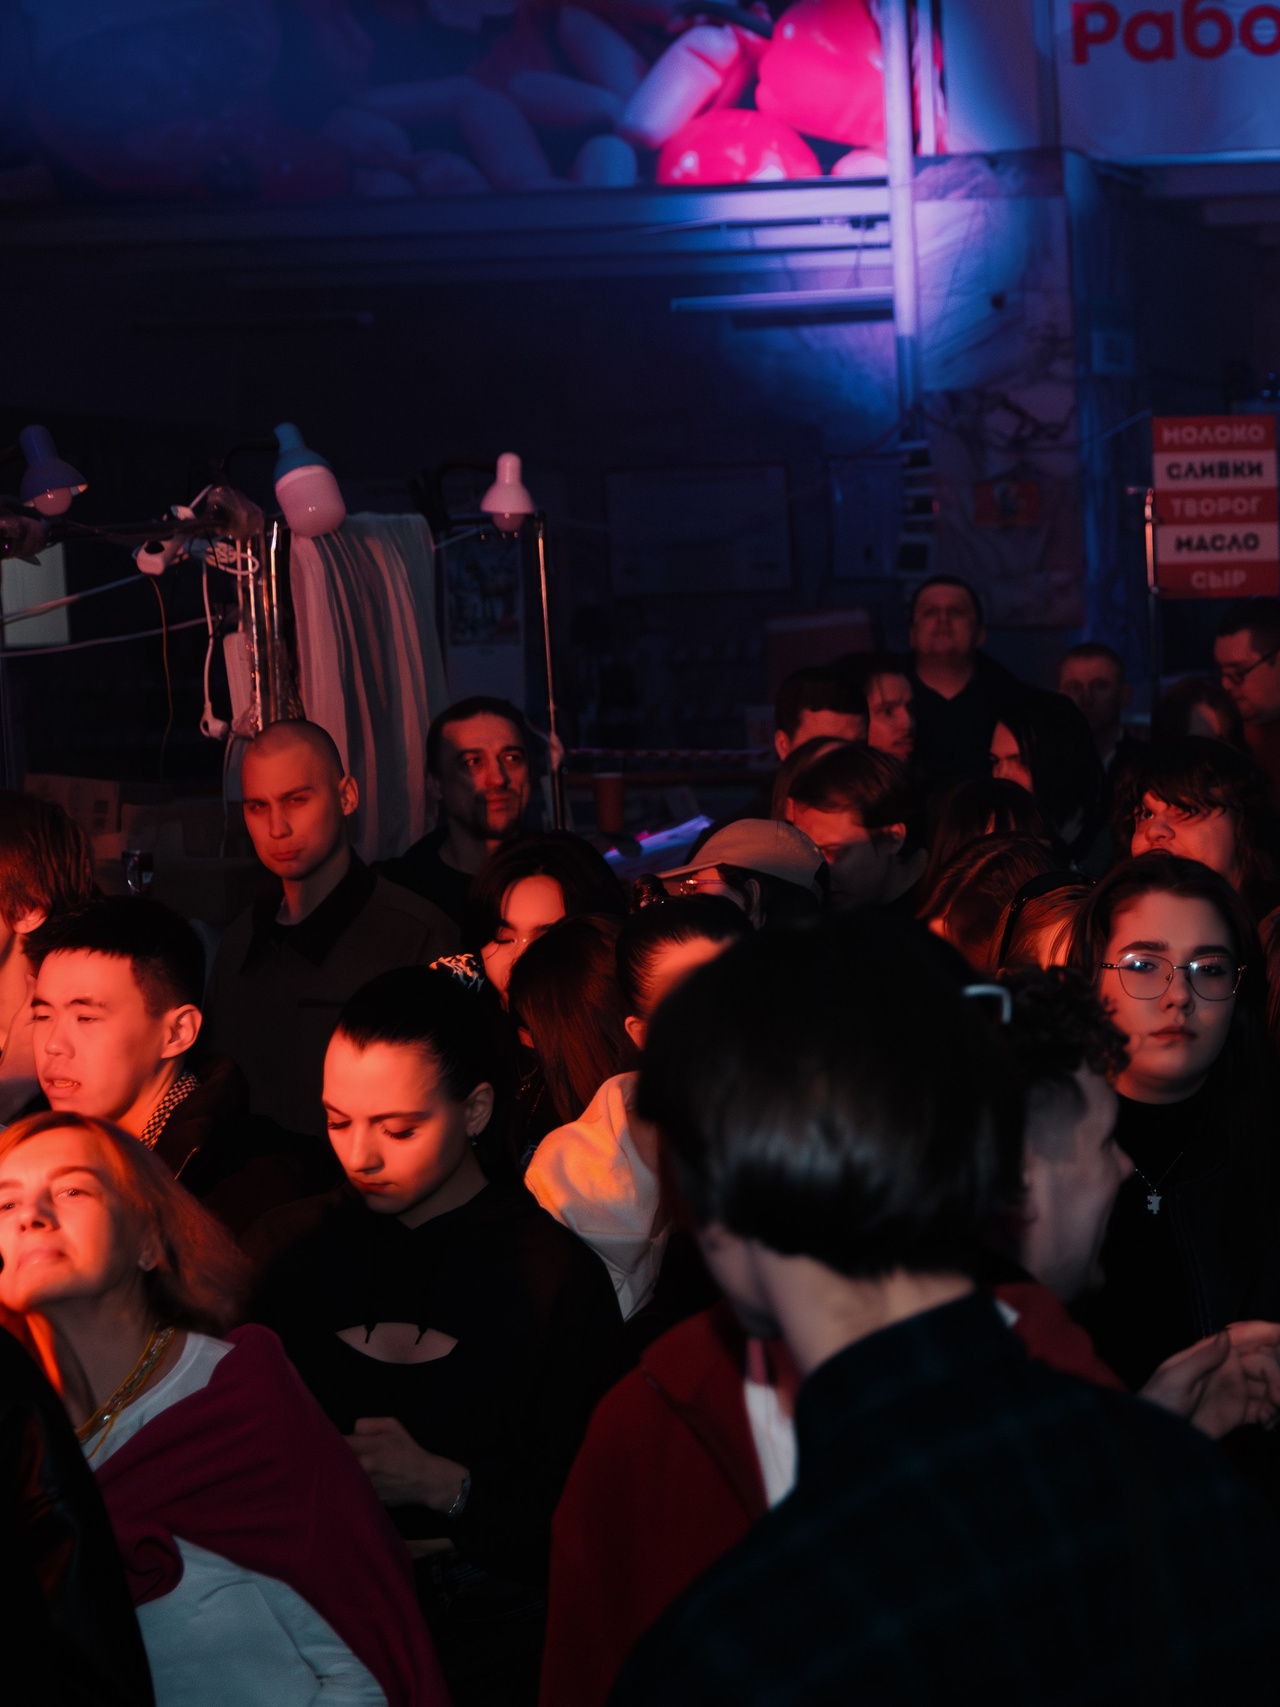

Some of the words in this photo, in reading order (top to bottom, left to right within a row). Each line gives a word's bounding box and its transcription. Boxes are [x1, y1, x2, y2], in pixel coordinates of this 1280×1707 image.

[1161, 424, 1265, 444] МОЛОКО
[1167, 460, 1263, 480] СЛИВКИ
[1170, 495, 1262, 517] ТВОРОГ
[1175, 532, 1260, 552] МАСЛО
[1190, 568, 1246, 590] СЫР
